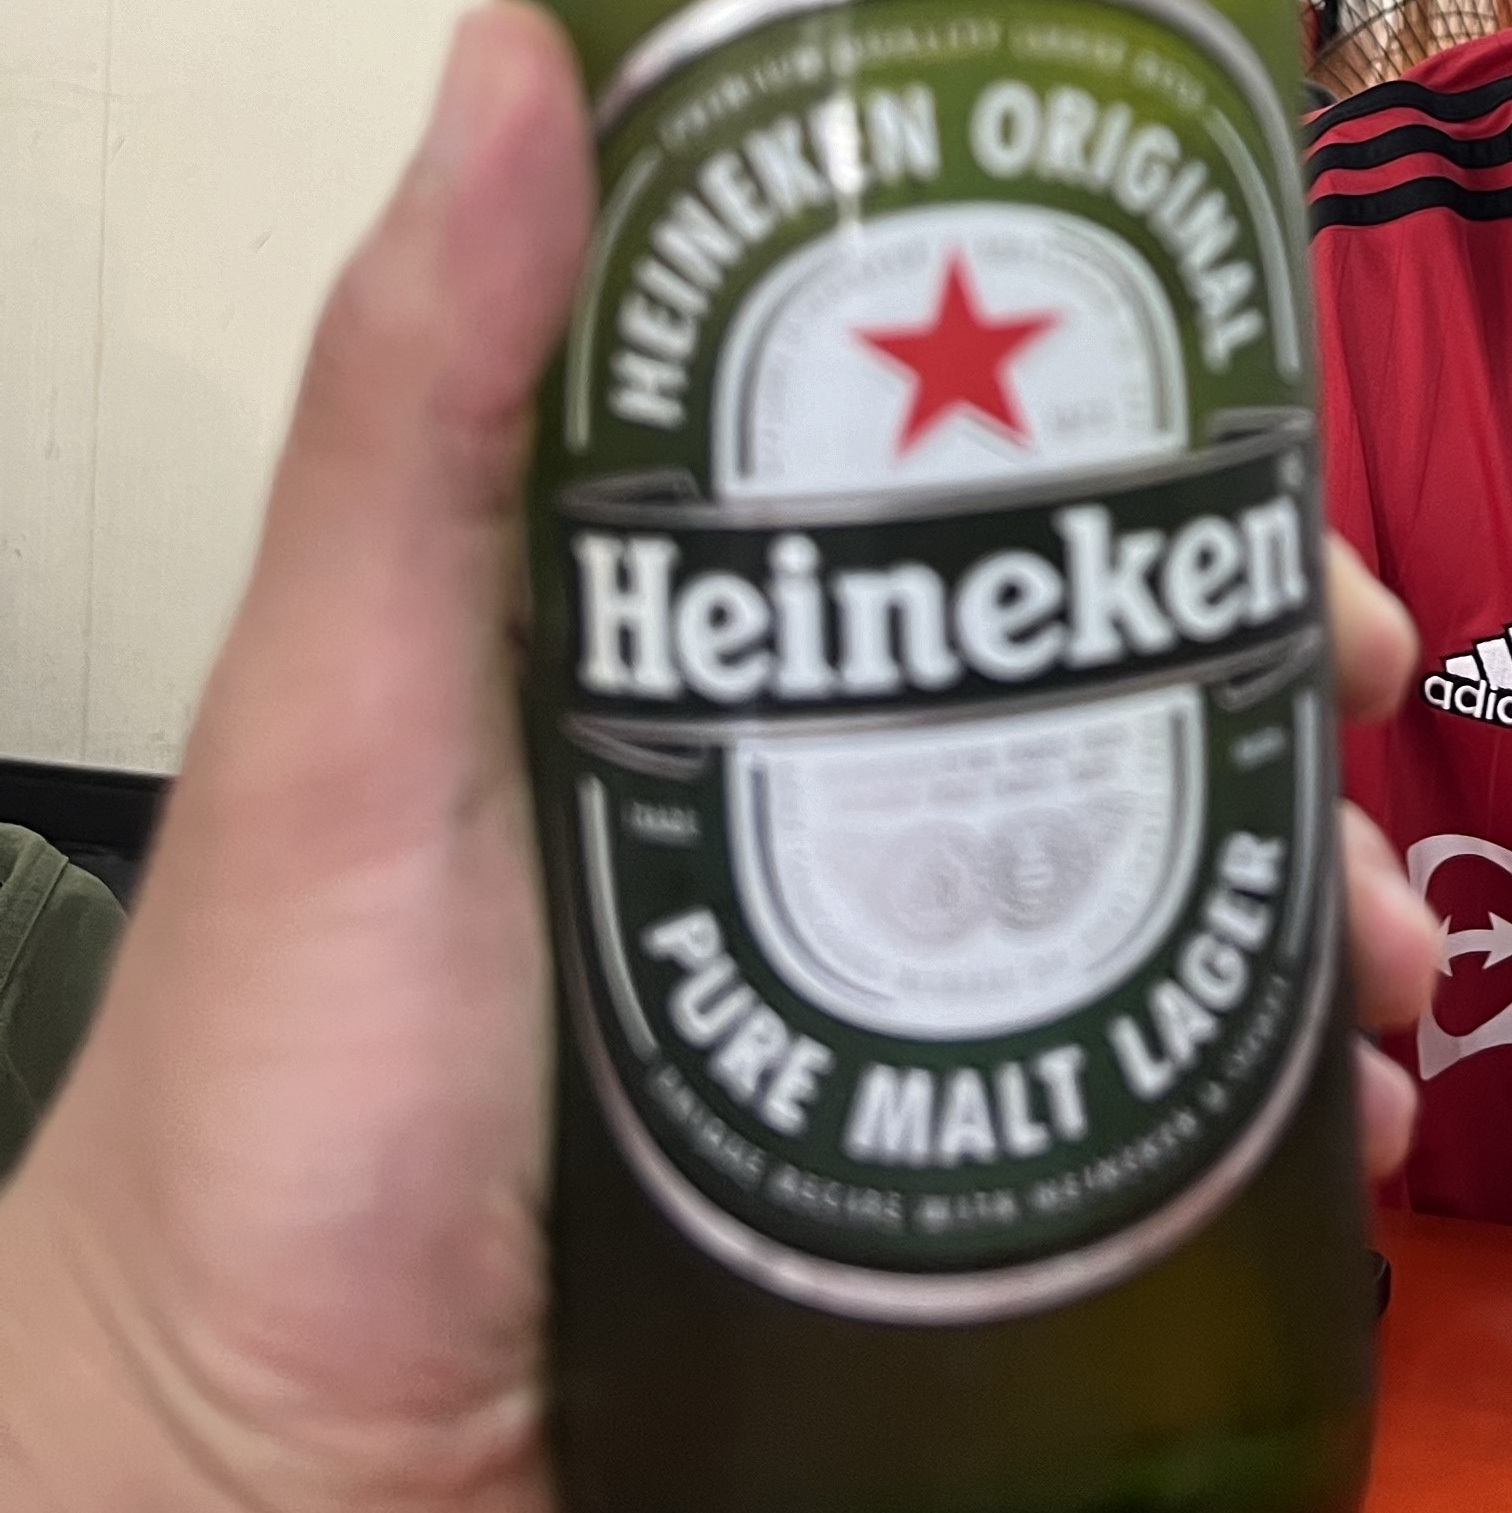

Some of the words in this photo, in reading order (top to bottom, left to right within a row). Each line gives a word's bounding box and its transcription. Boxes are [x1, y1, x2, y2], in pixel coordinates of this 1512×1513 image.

[608, 83, 942, 431] HEINEKEN
[970, 79, 1262, 372] ORIGINAL
[572, 496, 1309, 704] Heineken
[641, 907, 836, 1137] PURE
[844, 1043, 1088, 1166] MALT
[1108, 829, 1287, 1100] LAGER
